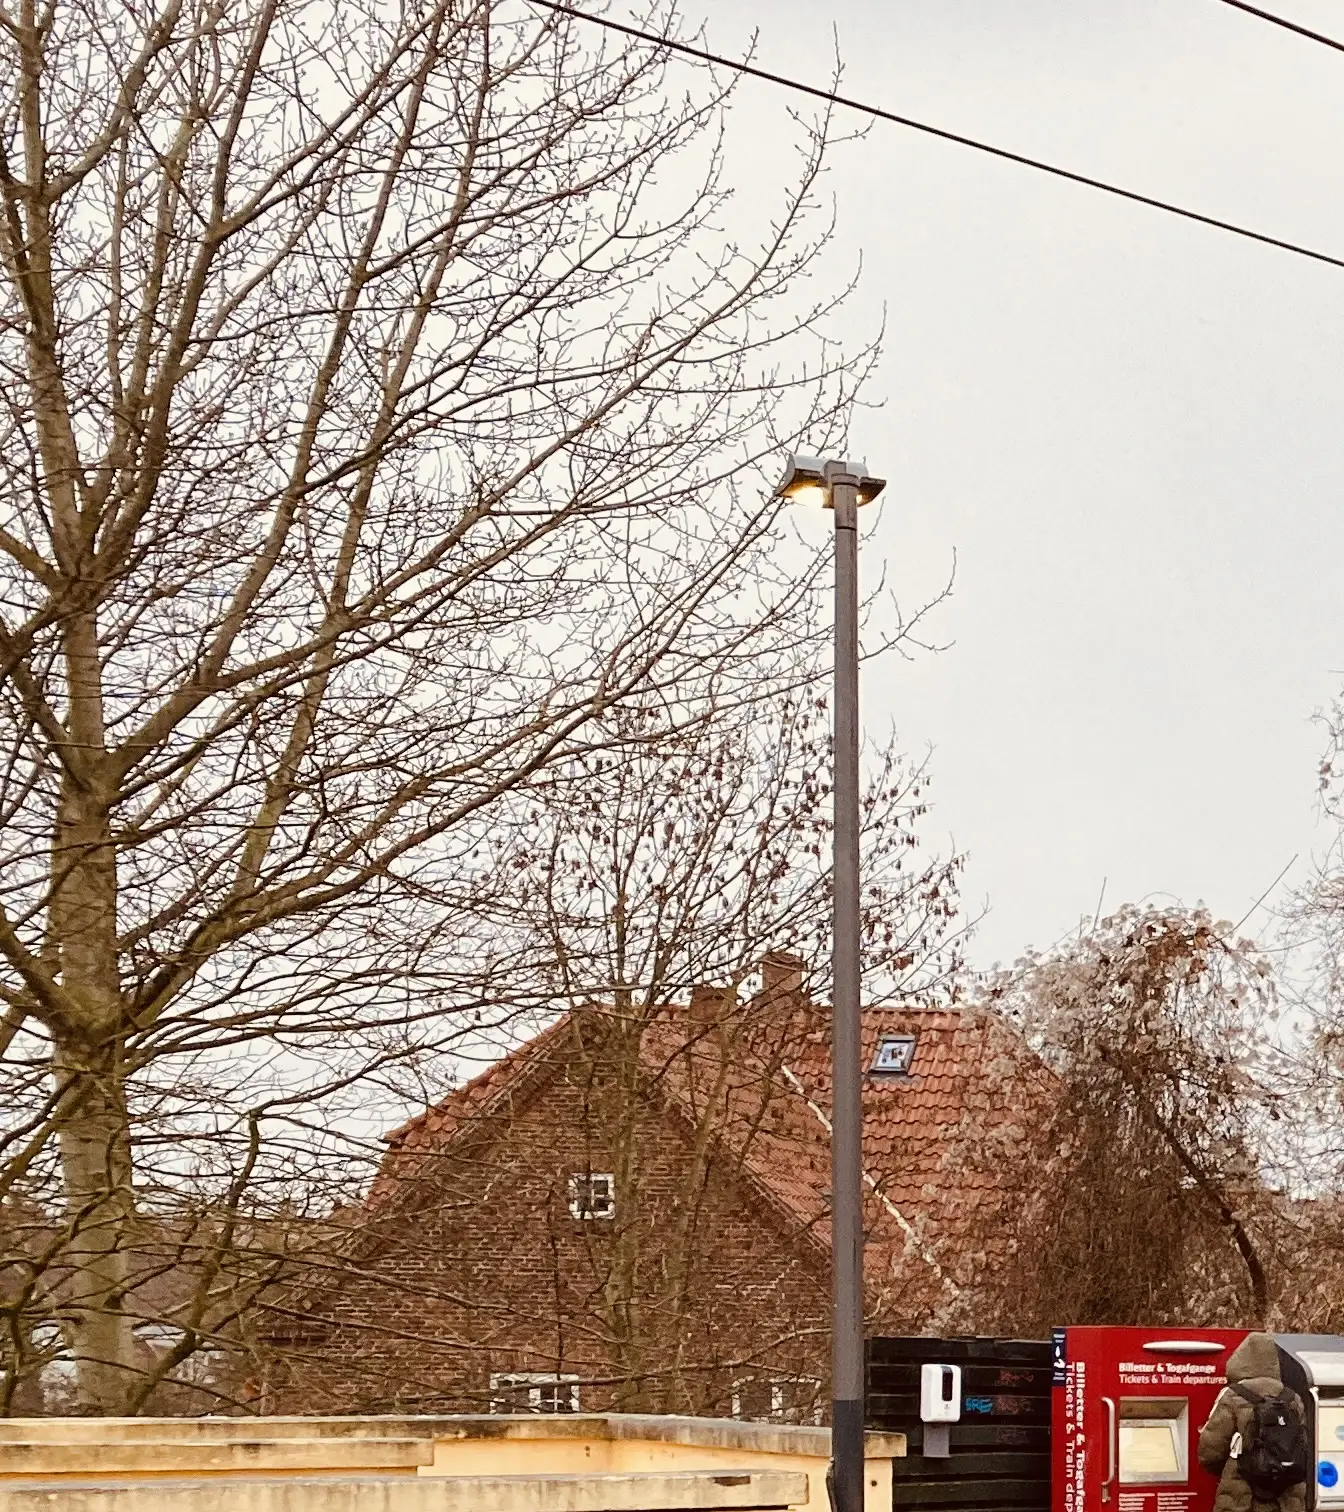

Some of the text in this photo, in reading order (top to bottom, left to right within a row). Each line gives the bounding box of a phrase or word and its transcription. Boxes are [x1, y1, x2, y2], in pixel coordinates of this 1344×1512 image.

[1119, 1363, 1216, 1374] Billetter & Togafgange
[1119, 1374, 1228, 1385] Tickets & Train departures
[1065, 1361, 1075, 1418] Tickets
[1075, 1361, 1086, 1430] Billetter
[1065, 1423, 1075, 1434] &
[1076, 1433, 1086, 1446] &
[1065, 1440, 1075, 1479] Train
